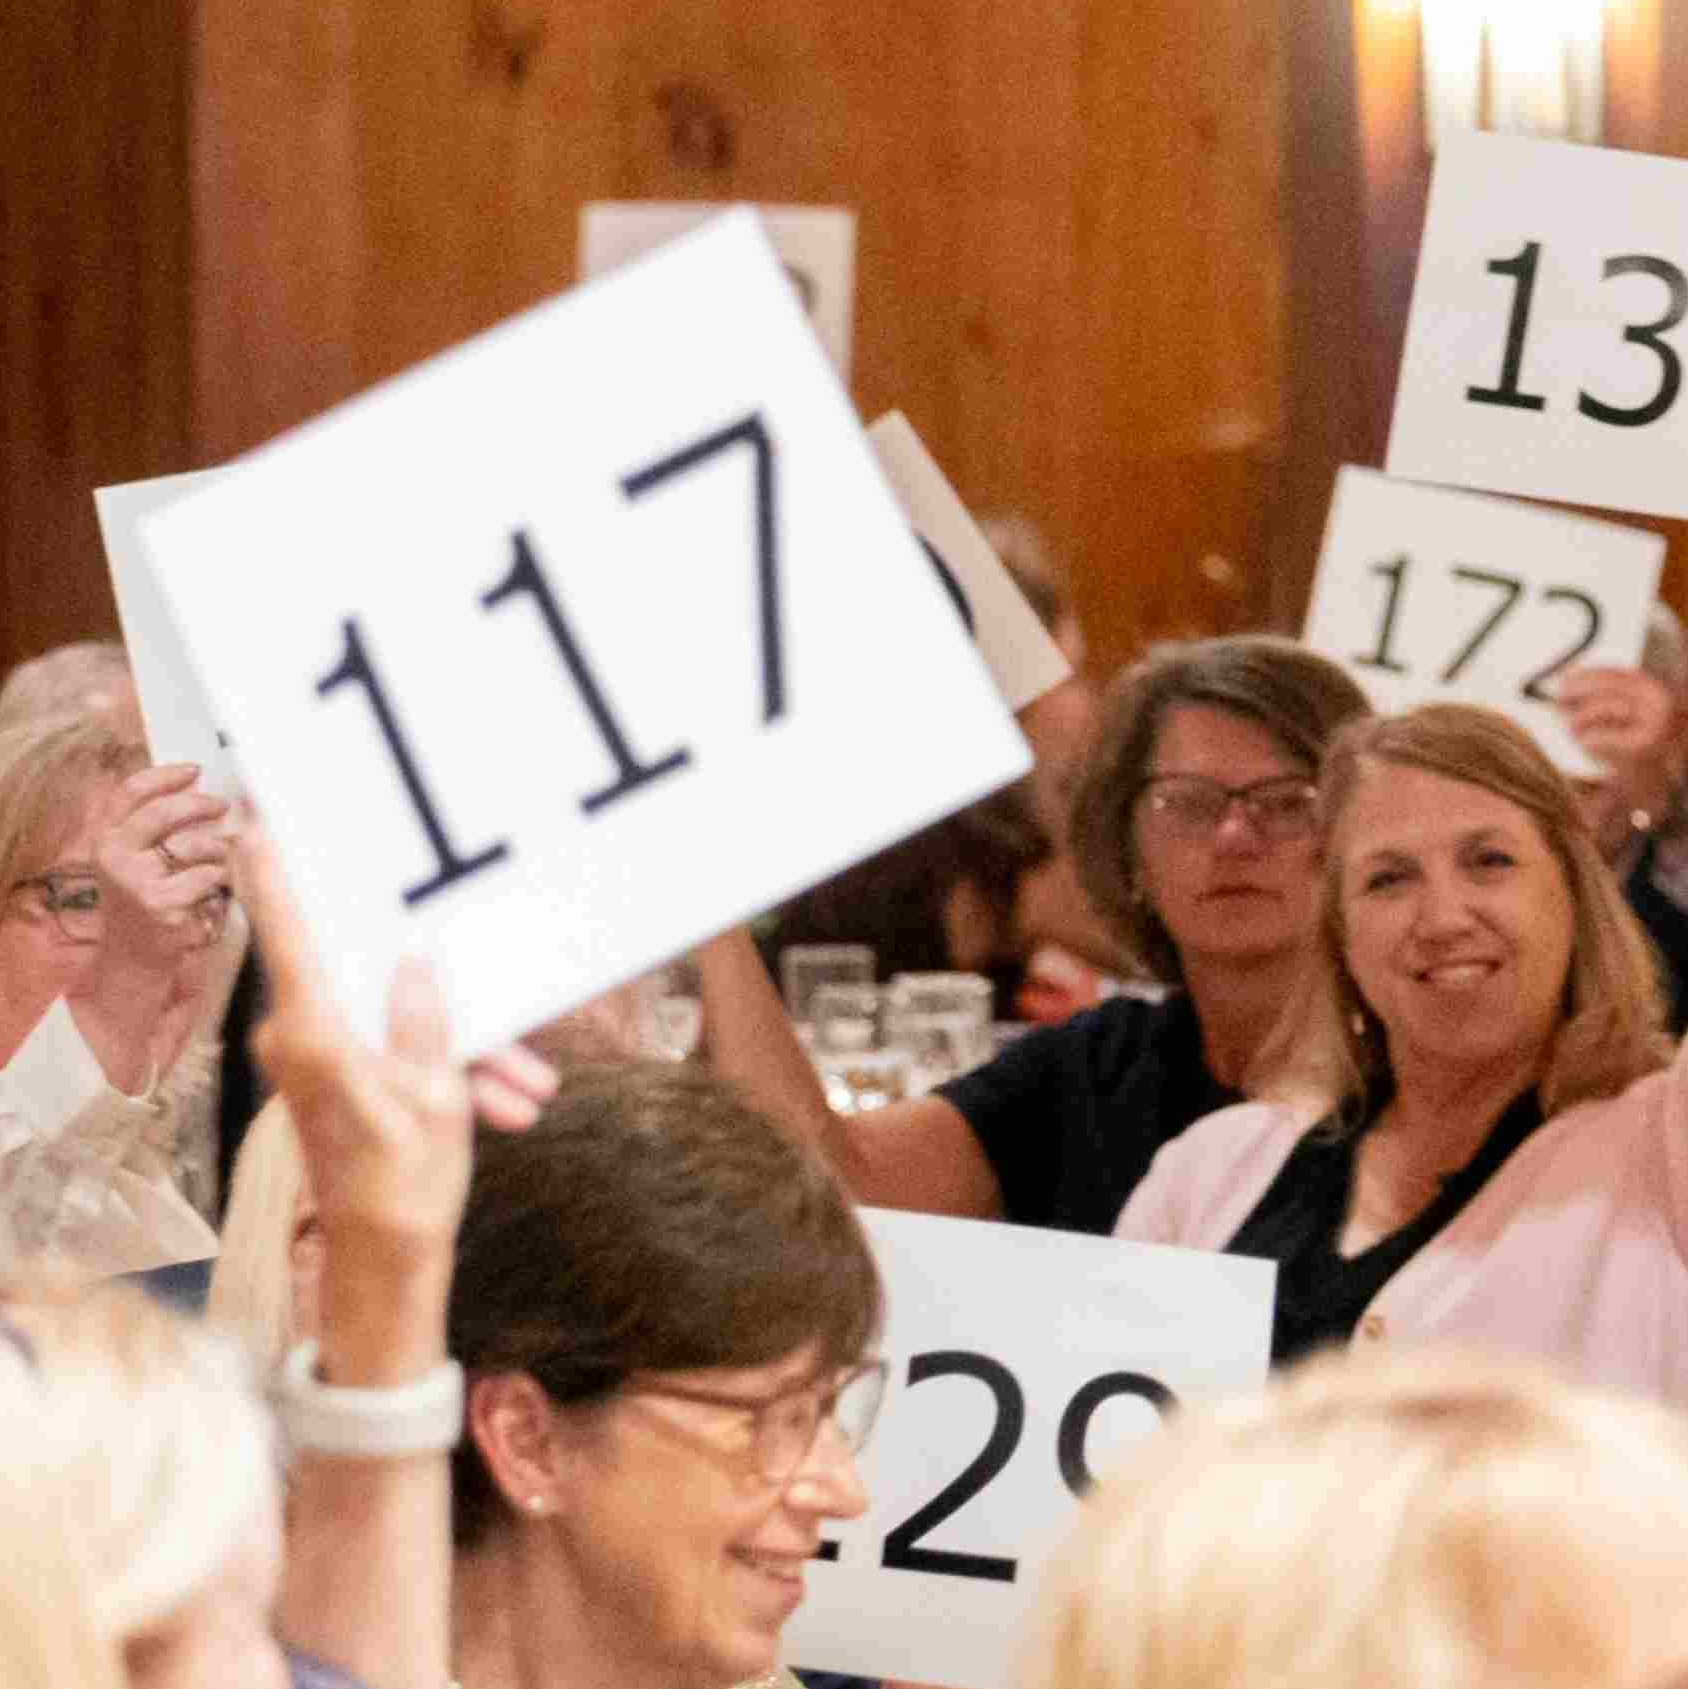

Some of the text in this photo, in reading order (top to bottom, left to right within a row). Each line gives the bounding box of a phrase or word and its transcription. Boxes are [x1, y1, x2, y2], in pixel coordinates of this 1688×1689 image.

[1465, 240, 1688, 429] 13
[313, 410, 788, 909] 117
[1351, 555, 1605, 703] 172
